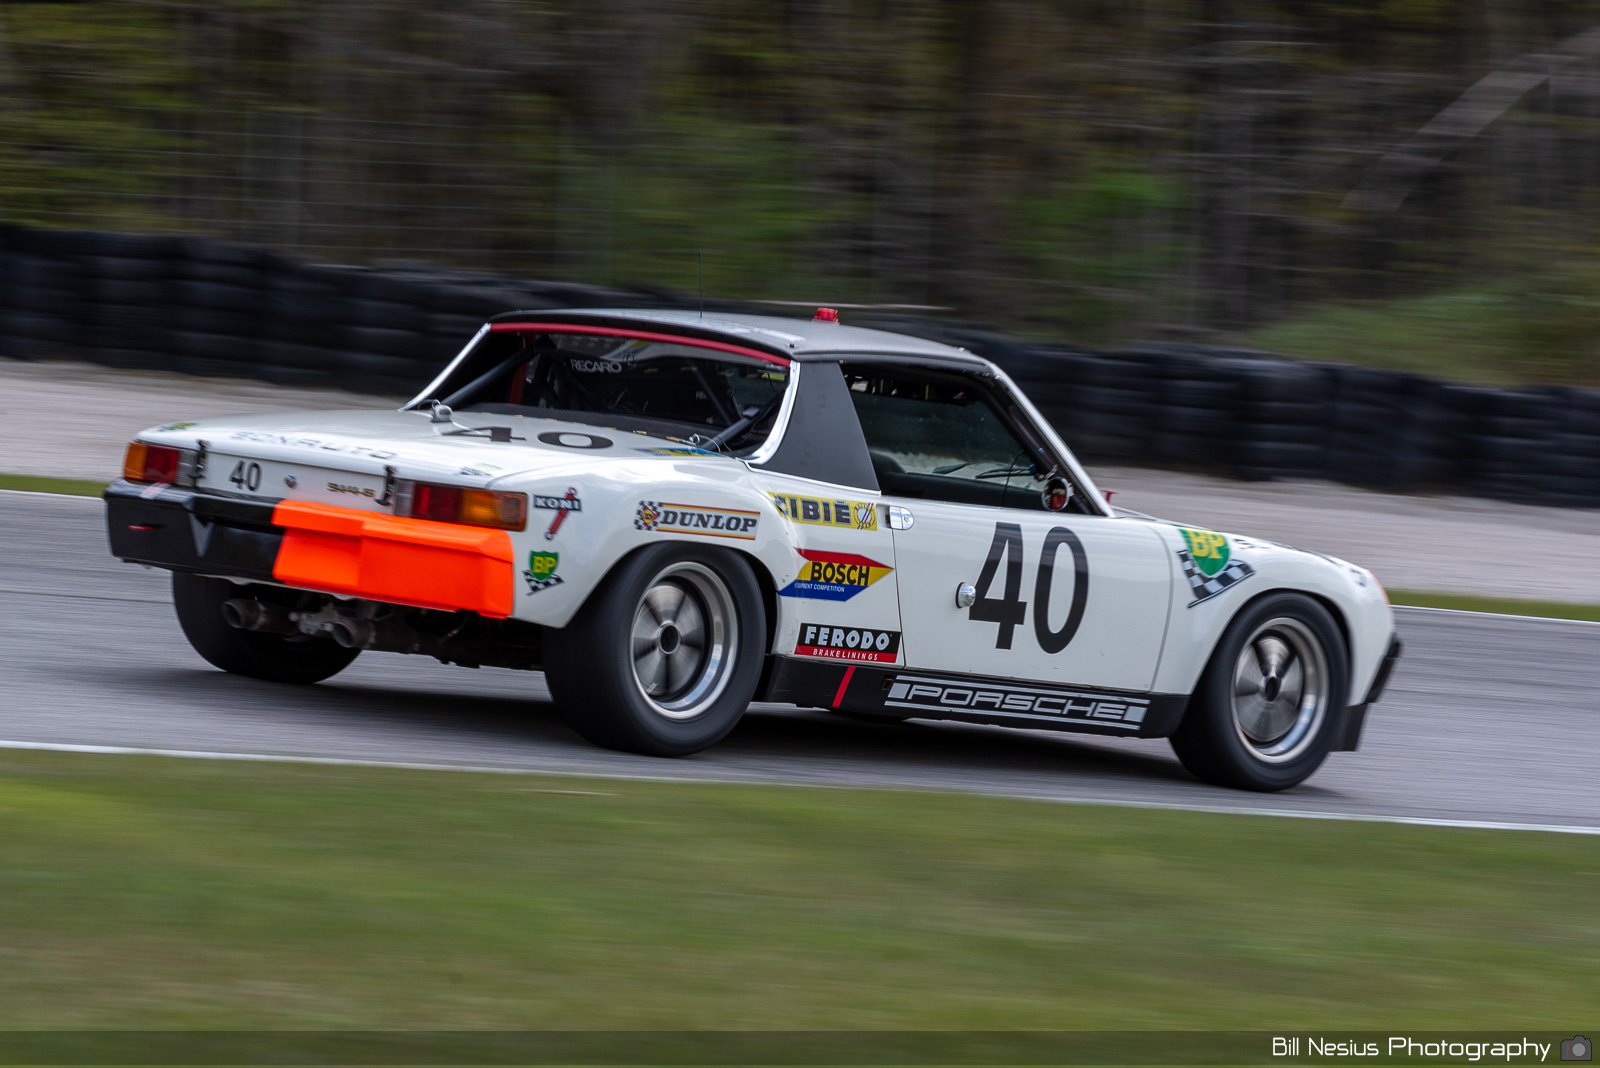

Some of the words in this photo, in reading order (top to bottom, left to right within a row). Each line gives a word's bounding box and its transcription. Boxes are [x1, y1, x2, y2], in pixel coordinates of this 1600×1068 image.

[570, 359, 622, 373] RECARO
[441, 426, 614, 449] 40
[229, 460, 262, 492] 40
[535, 497, 580, 511] KONI
[660, 510, 758, 532] DUNLOP
[1188, 528, 1226, 559] BP
[532, 556, 556, 574] BP
[810, 562, 870, 586] BOSCH
[969, 521, 1089, 654] 40
[804, 626, 890, 651] FERODO
[907, 684, 1128, 720] PORSCHE
